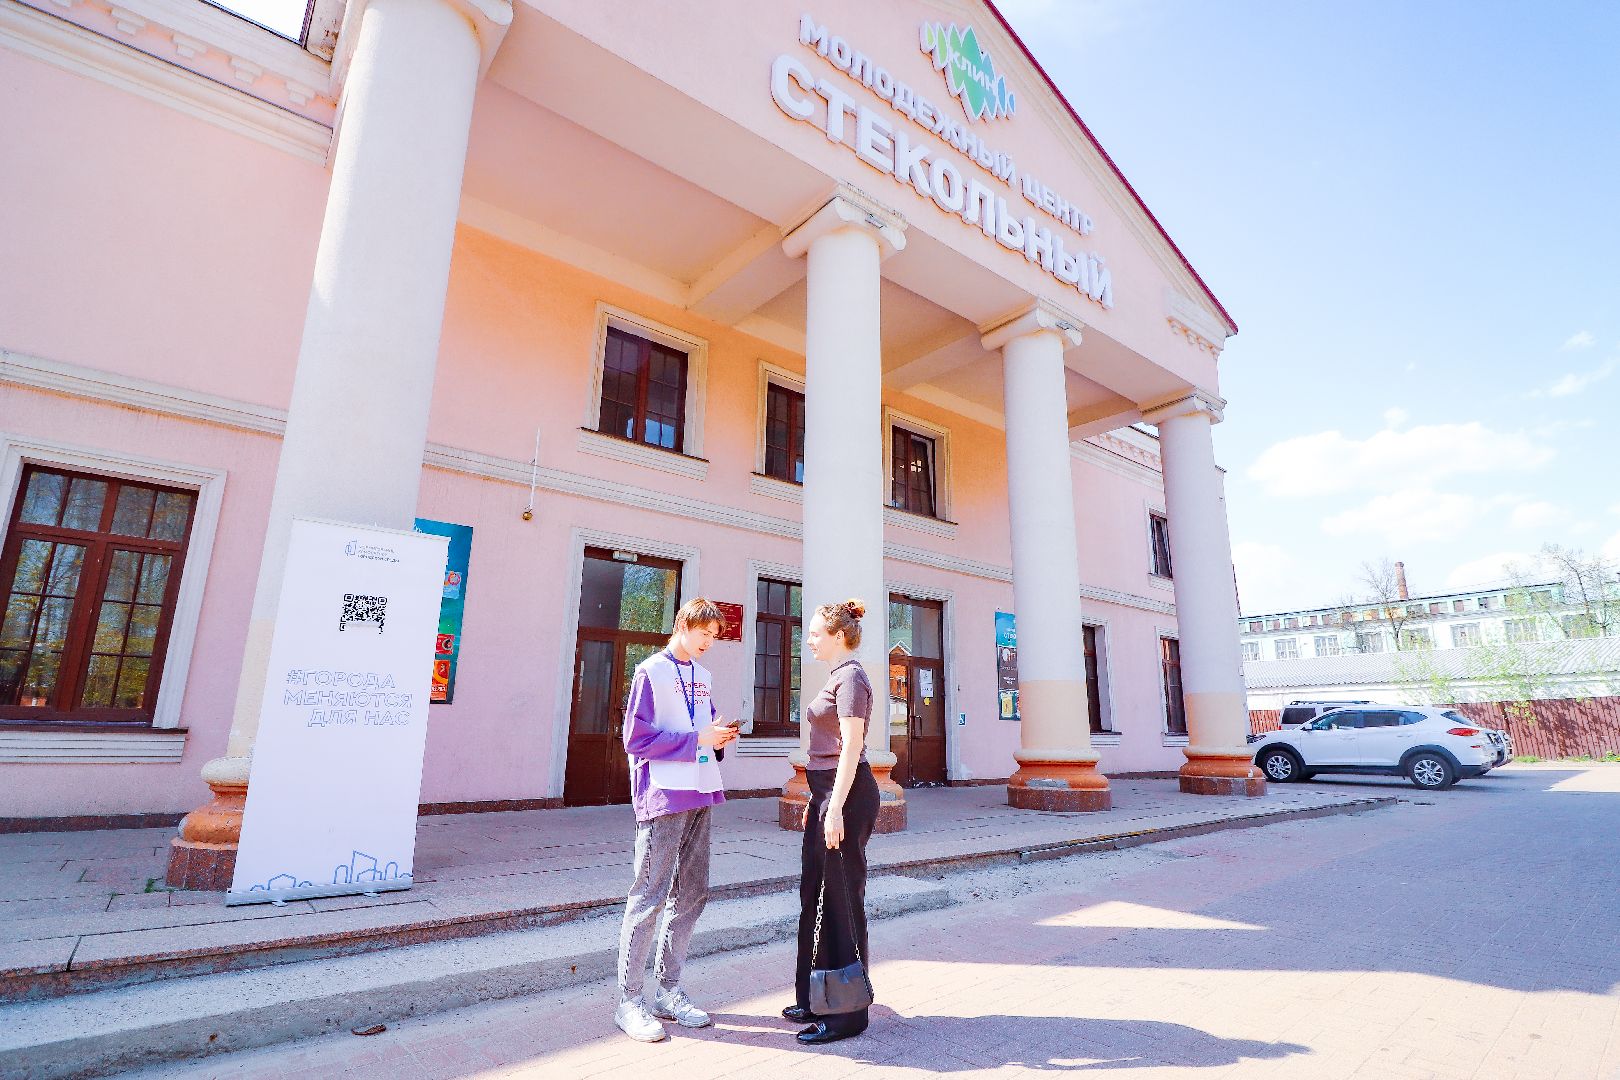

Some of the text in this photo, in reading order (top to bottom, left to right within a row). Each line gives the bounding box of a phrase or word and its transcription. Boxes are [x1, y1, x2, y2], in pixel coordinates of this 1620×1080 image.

[950, 50, 997, 96] КЛИН
[799, 13, 1096, 237] МОЛОДЕЖНЫЙ ЦЕНТР
[771, 54, 1114, 310] СТЕКОЛЬНЫЙ
[285, 669, 396, 690] #ГОРОДА
[283, 689, 413, 708] МЕНЯЮТСЯ
[307, 708, 411, 727] ДЛЯ НАС
